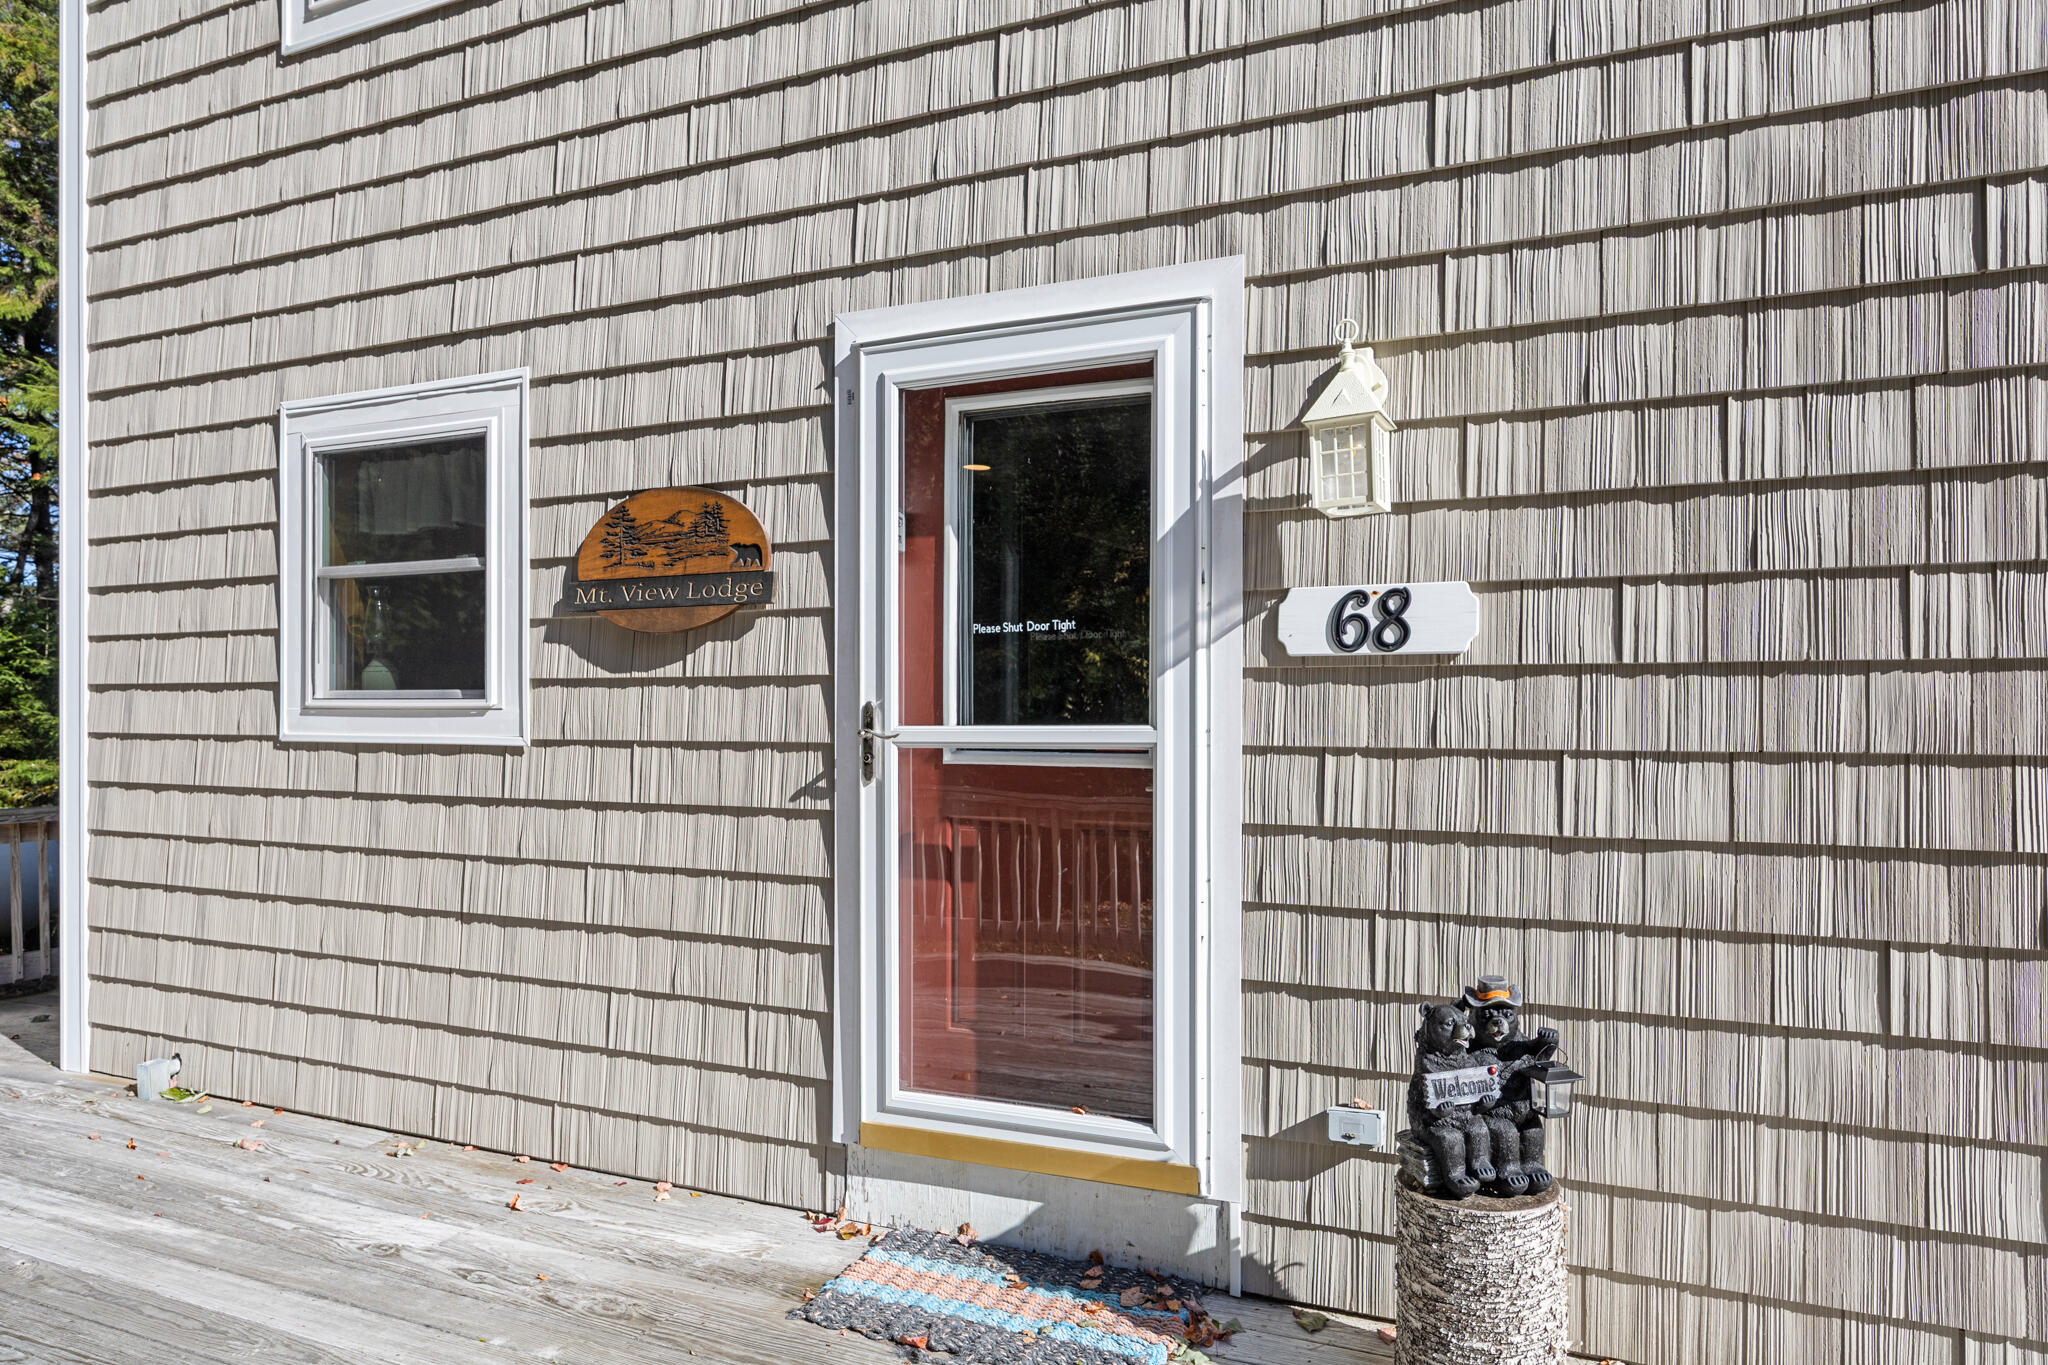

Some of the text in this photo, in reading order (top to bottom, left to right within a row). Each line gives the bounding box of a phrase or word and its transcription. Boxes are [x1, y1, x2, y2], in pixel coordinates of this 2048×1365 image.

[574, 577, 764, 605] Mt. View Lodge
[973, 619, 1076, 634] Please Shut Door Tight
[1331, 586, 1412, 653] 68
[1430, 1076, 1496, 1100] Welcome
